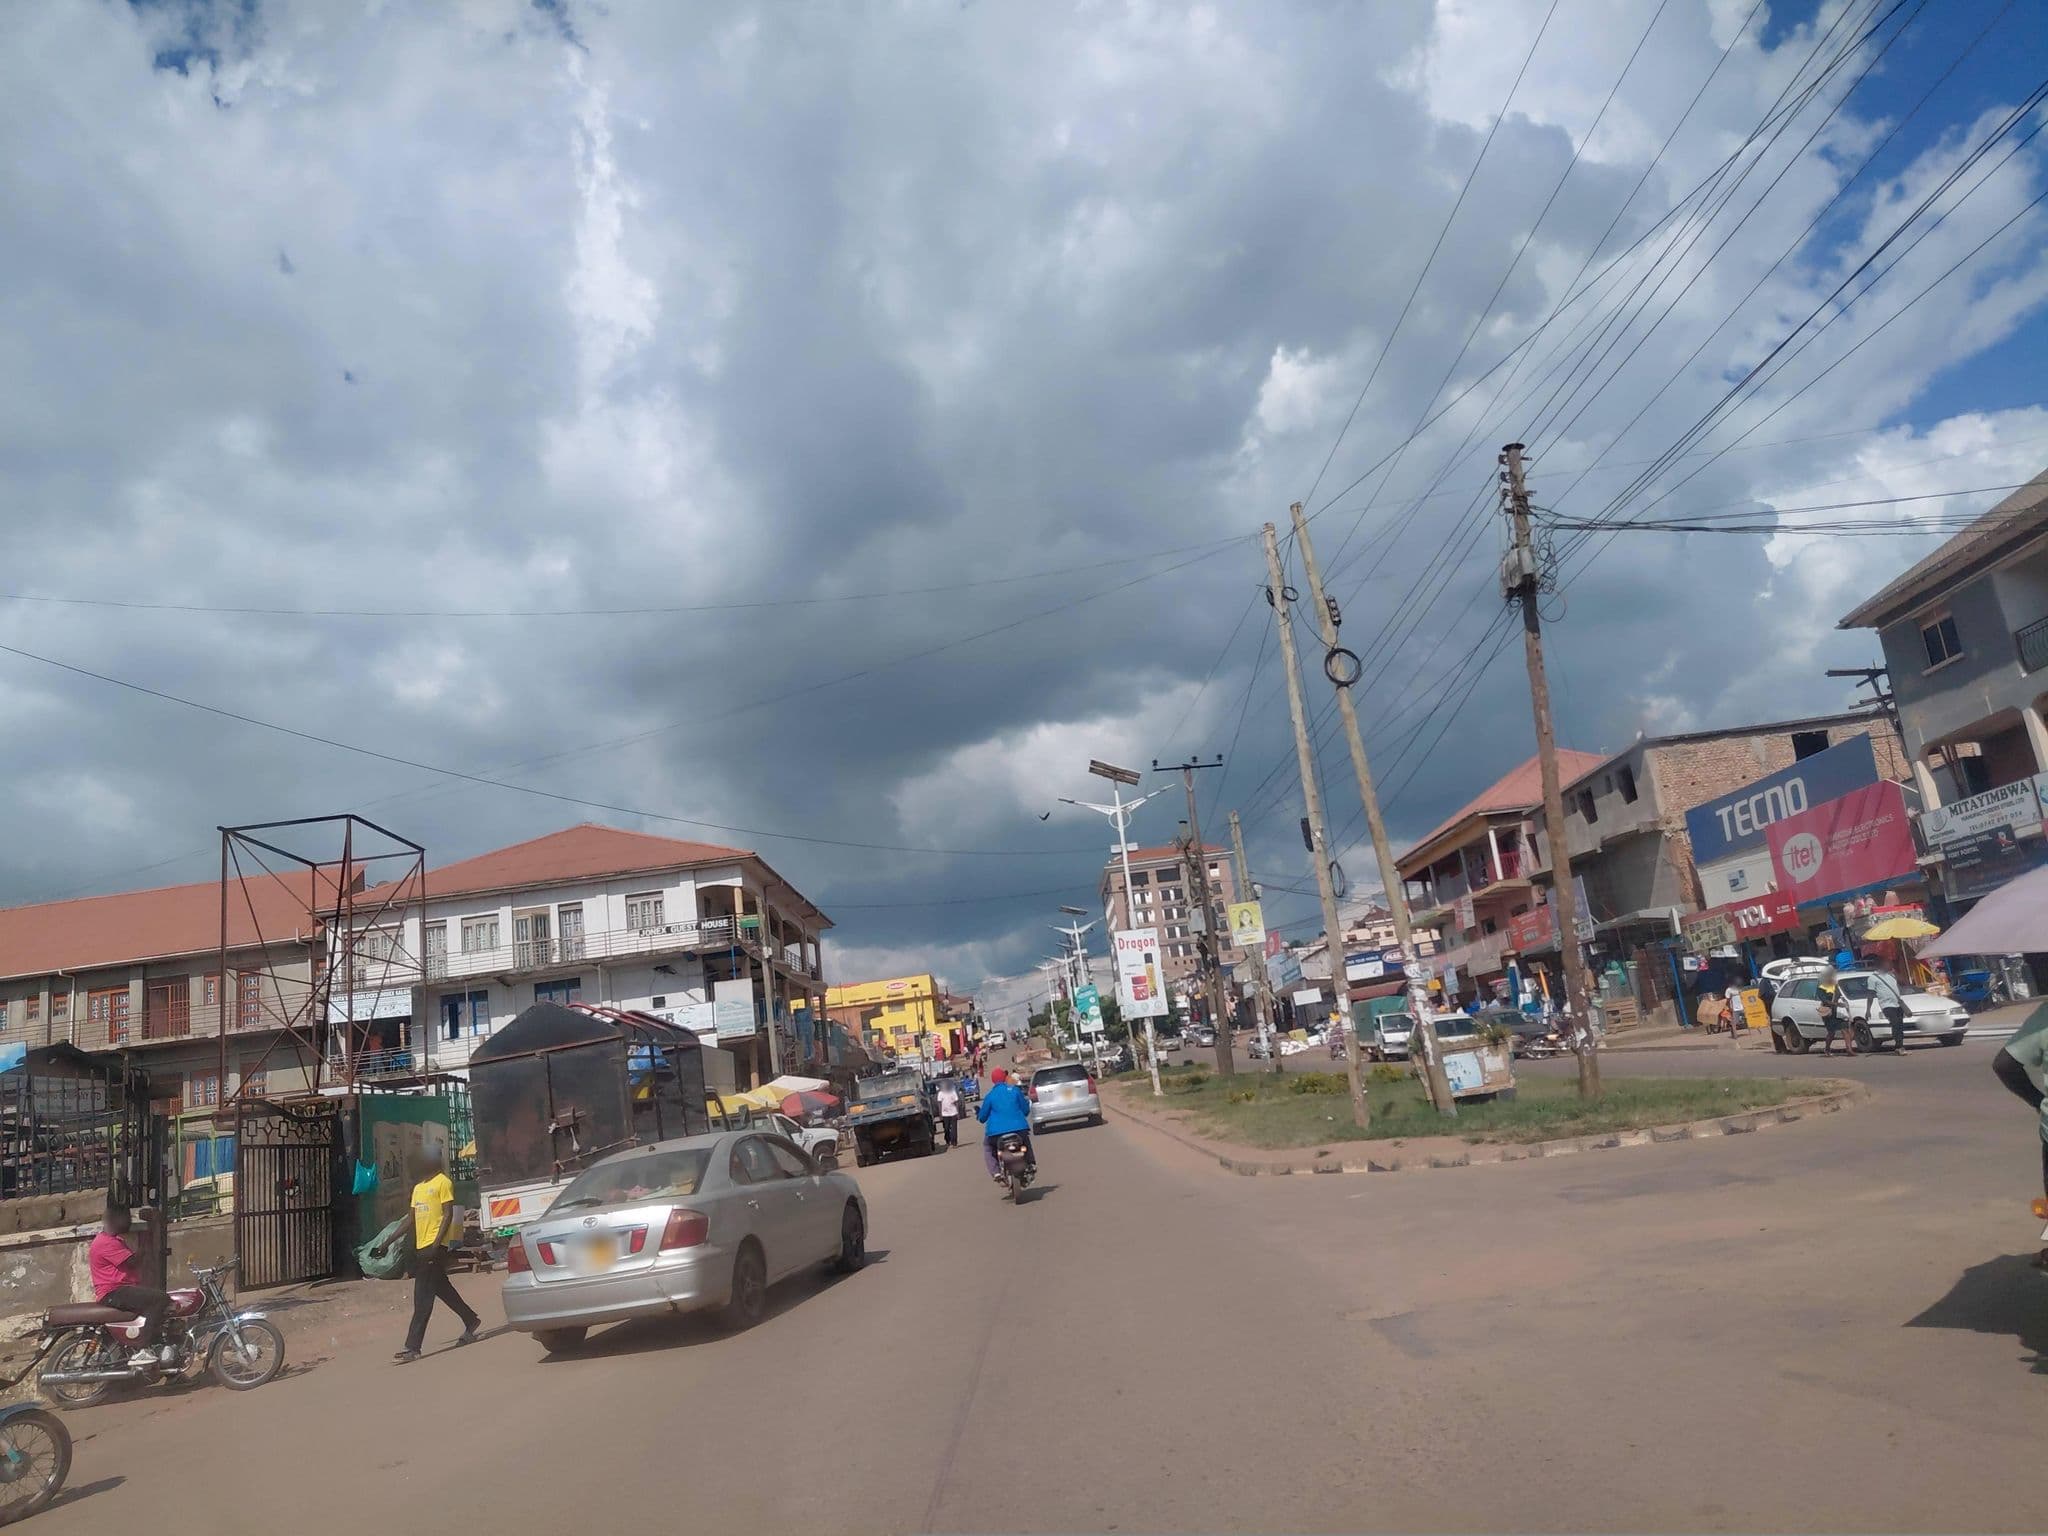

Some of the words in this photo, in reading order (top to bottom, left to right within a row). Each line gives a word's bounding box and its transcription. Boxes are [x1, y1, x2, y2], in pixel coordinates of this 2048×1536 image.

[1715, 776, 1809, 842] TECNO
[1948, 781, 2030, 818] MITAYIMBWA
[1790, 839, 1817, 870] itel
[640, 925, 668, 938] JONEX
[670, 923, 698, 934] GUEST
[700, 919, 729, 930] HOUSE
[1734, 904, 1772, 929] TCL
[1118, 937, 1156, 952] Dragon
